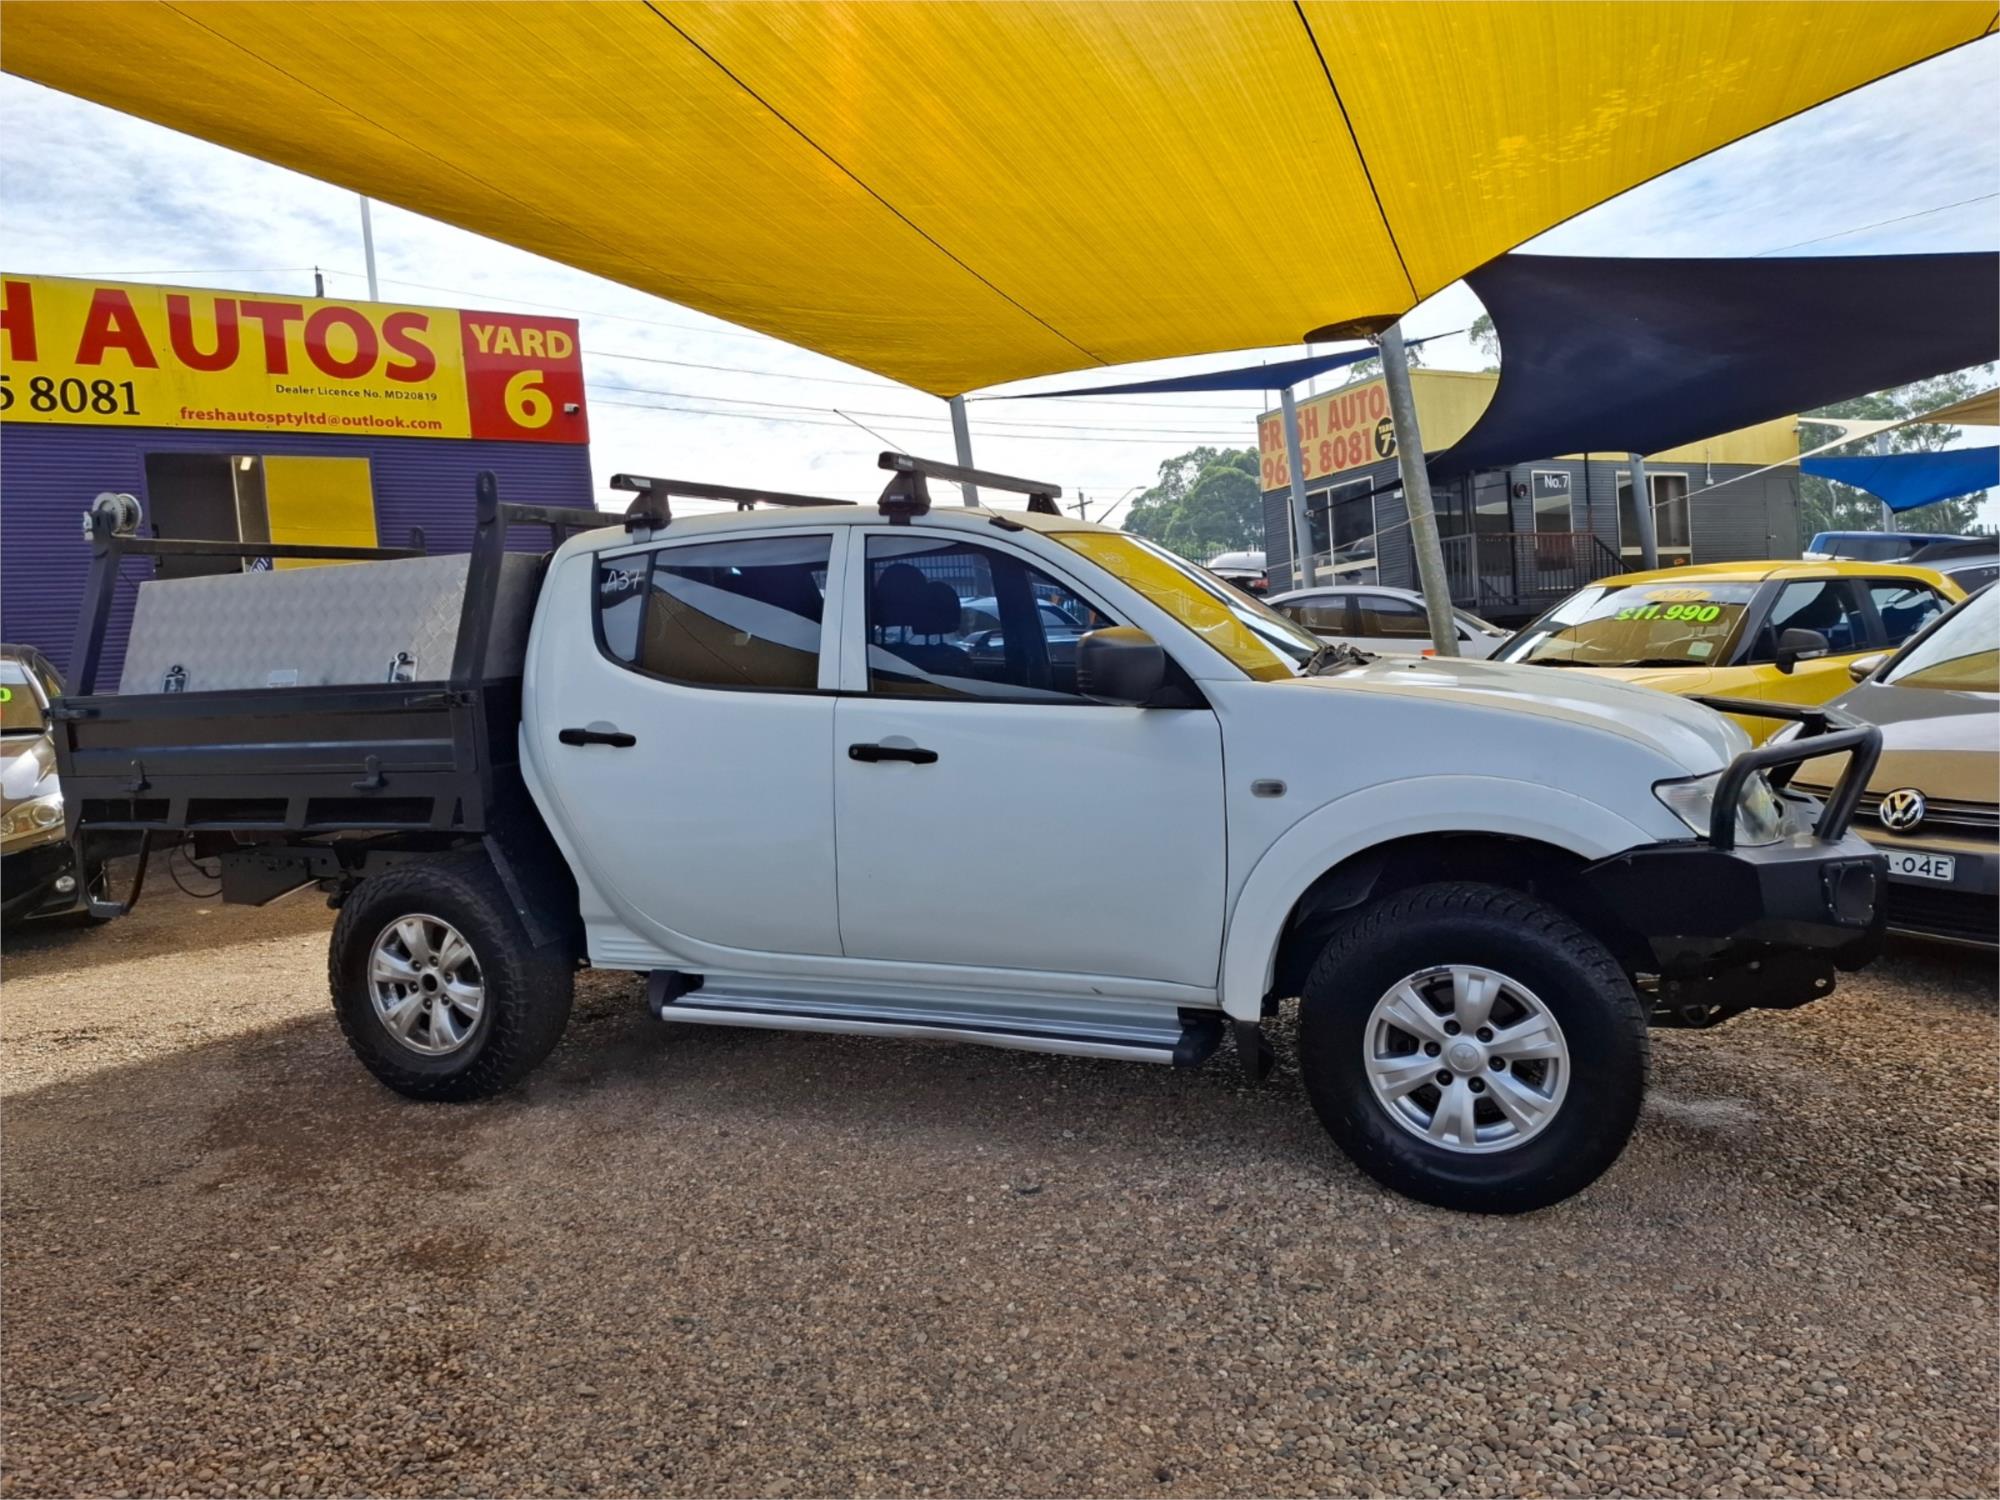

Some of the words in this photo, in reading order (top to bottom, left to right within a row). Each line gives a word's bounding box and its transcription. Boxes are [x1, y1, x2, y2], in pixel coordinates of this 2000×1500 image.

[75, 288, 437, 383] AUTOS
[469, 323, 573, 359] YARD
[29, 376, 140, 415] 8081
[275, 384, 315, 395] Dealer
[318, 387, 360, 397] Licence
[363, 389, 382, 399] No.
[384, 390, 437, 401] MD20819
[504, 370, 553, 429] 6
[180, 407, 443, 430] freshautosptyltd@outlook.com
[1261, 406, 1319, 454] FRSH
[1327, 385, 1391, 434] AUTO
[1262, 446, 1311, 488] 965
[1319, 427, 1372, 473] 8081
[1381, 433, 1392, 454] 7
[605, 569, 645, 593] A37
